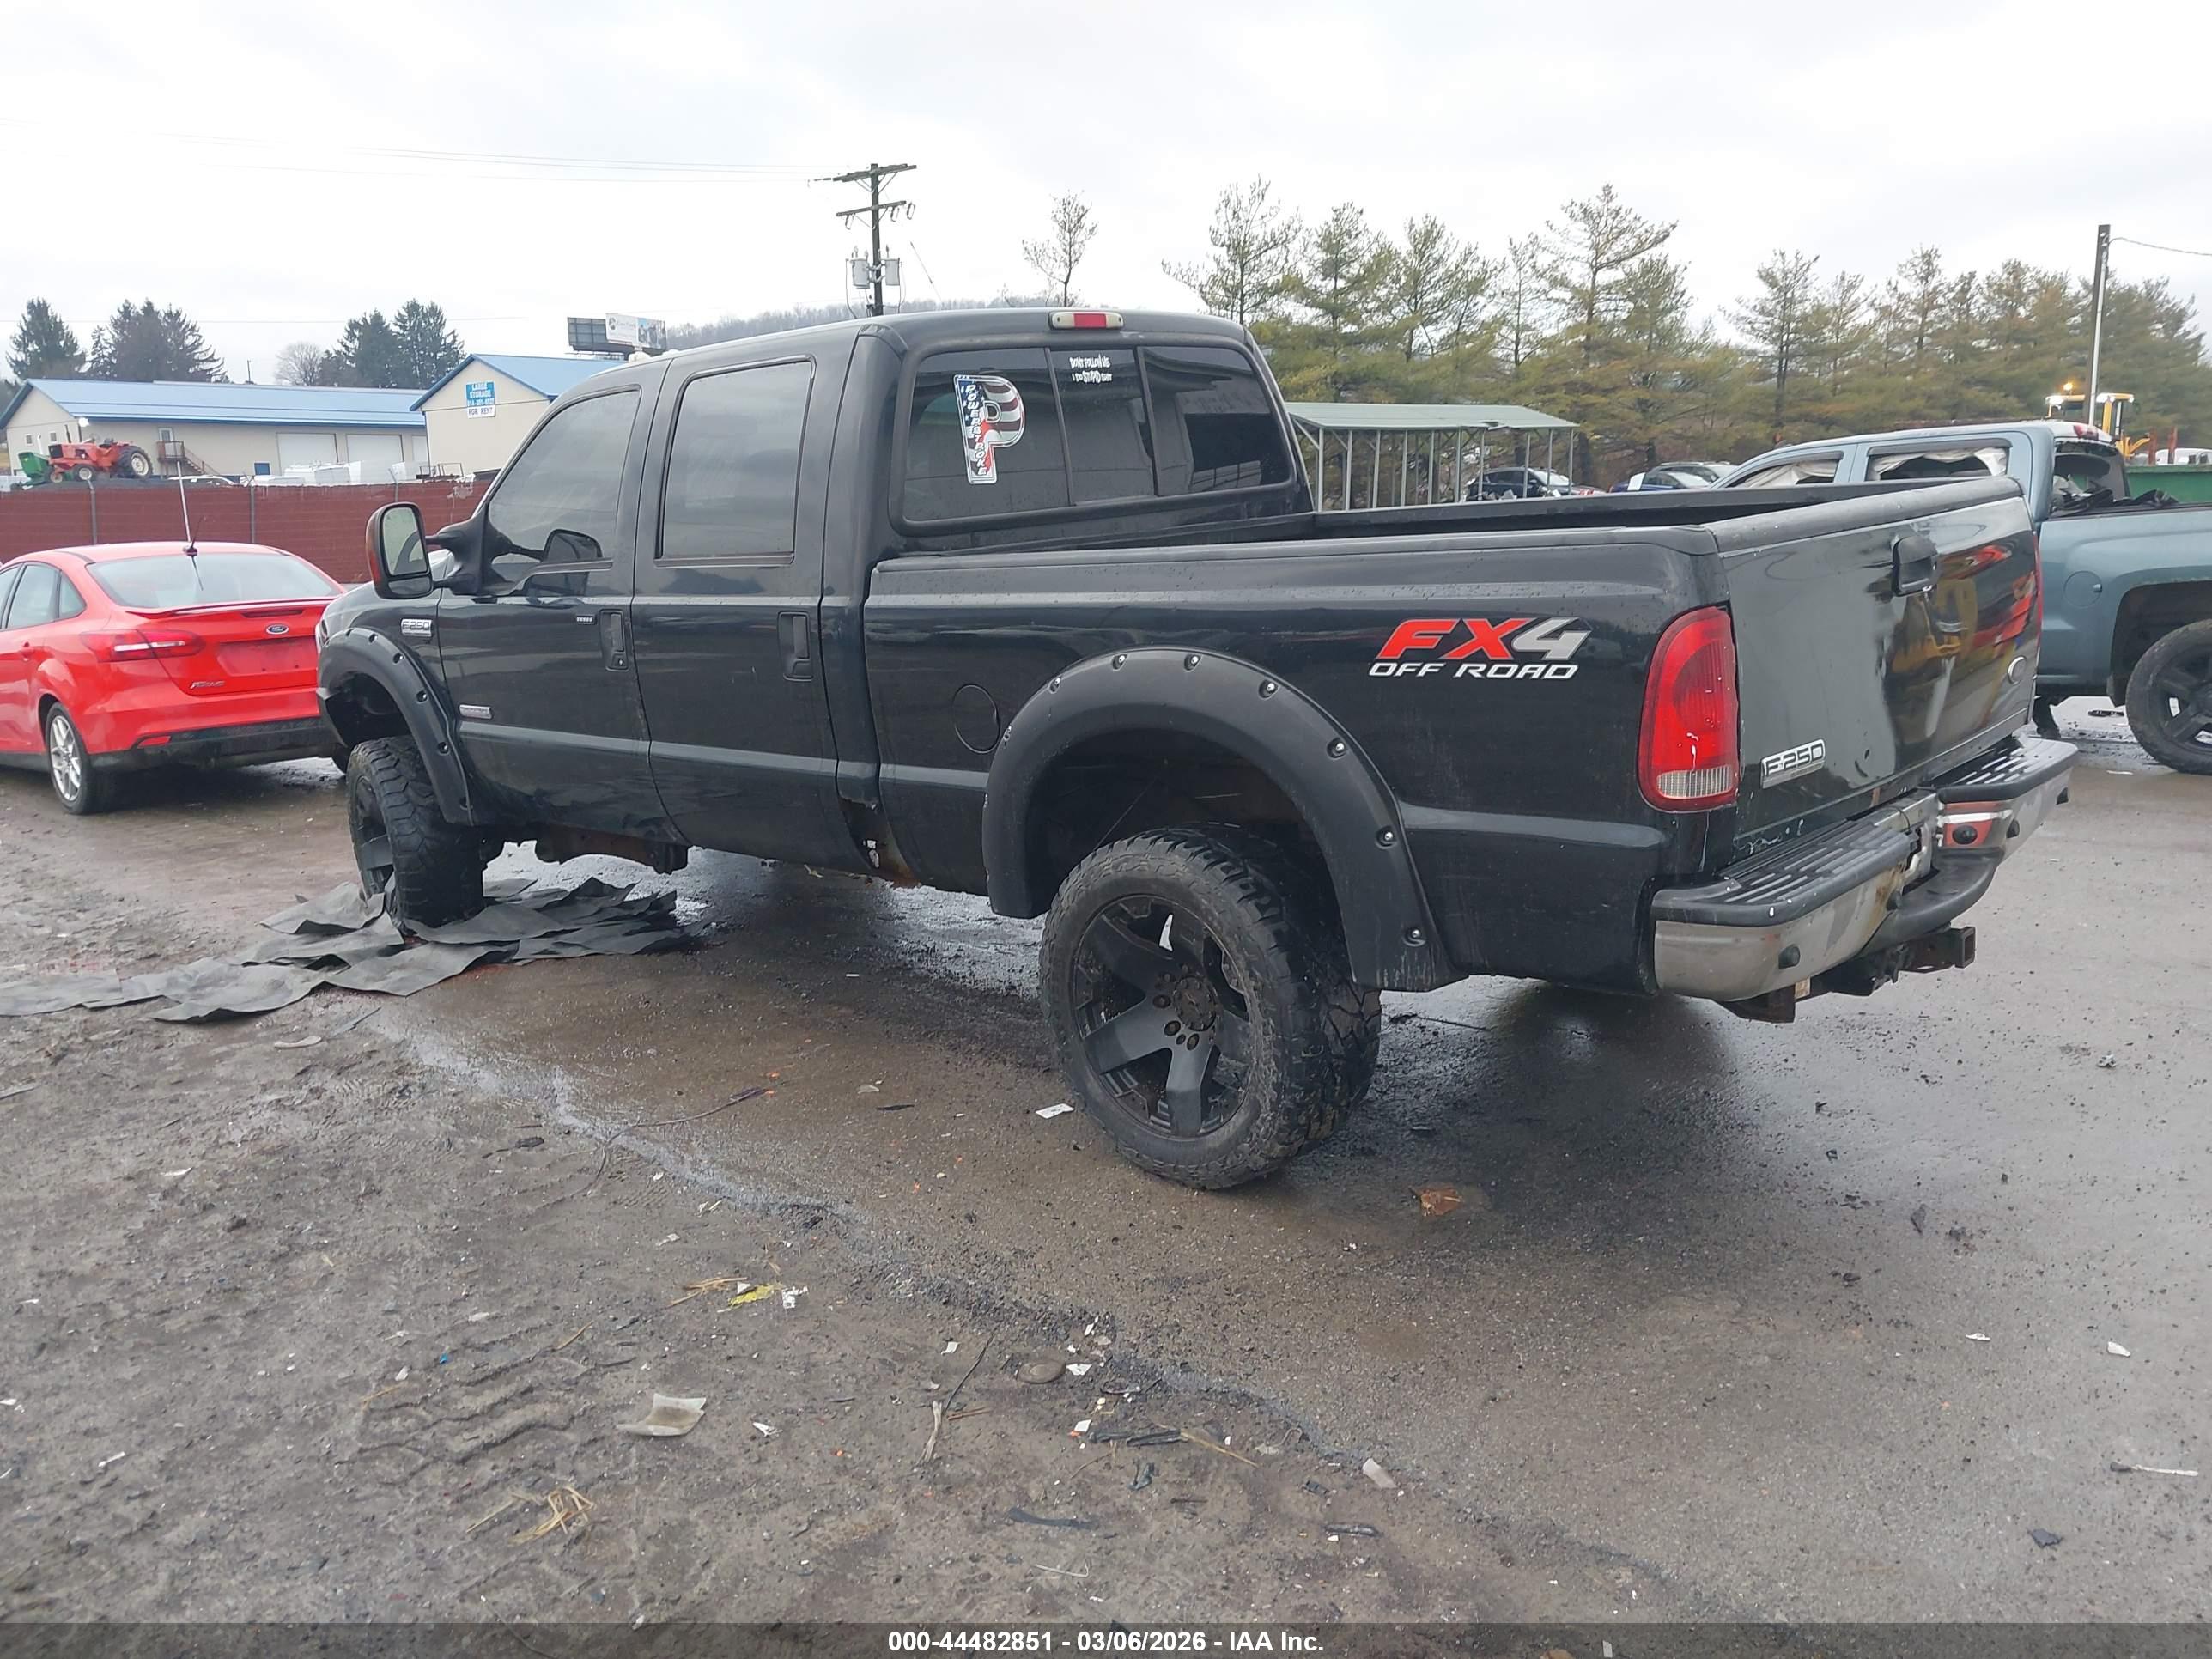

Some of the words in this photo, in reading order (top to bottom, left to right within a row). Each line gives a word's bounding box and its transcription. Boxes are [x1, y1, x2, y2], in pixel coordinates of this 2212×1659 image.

[1375, 617, 1592, 660] FX4
[1369, 662, 1446, 678] OFF
[1453, 663, 1579, 680] ROAD
